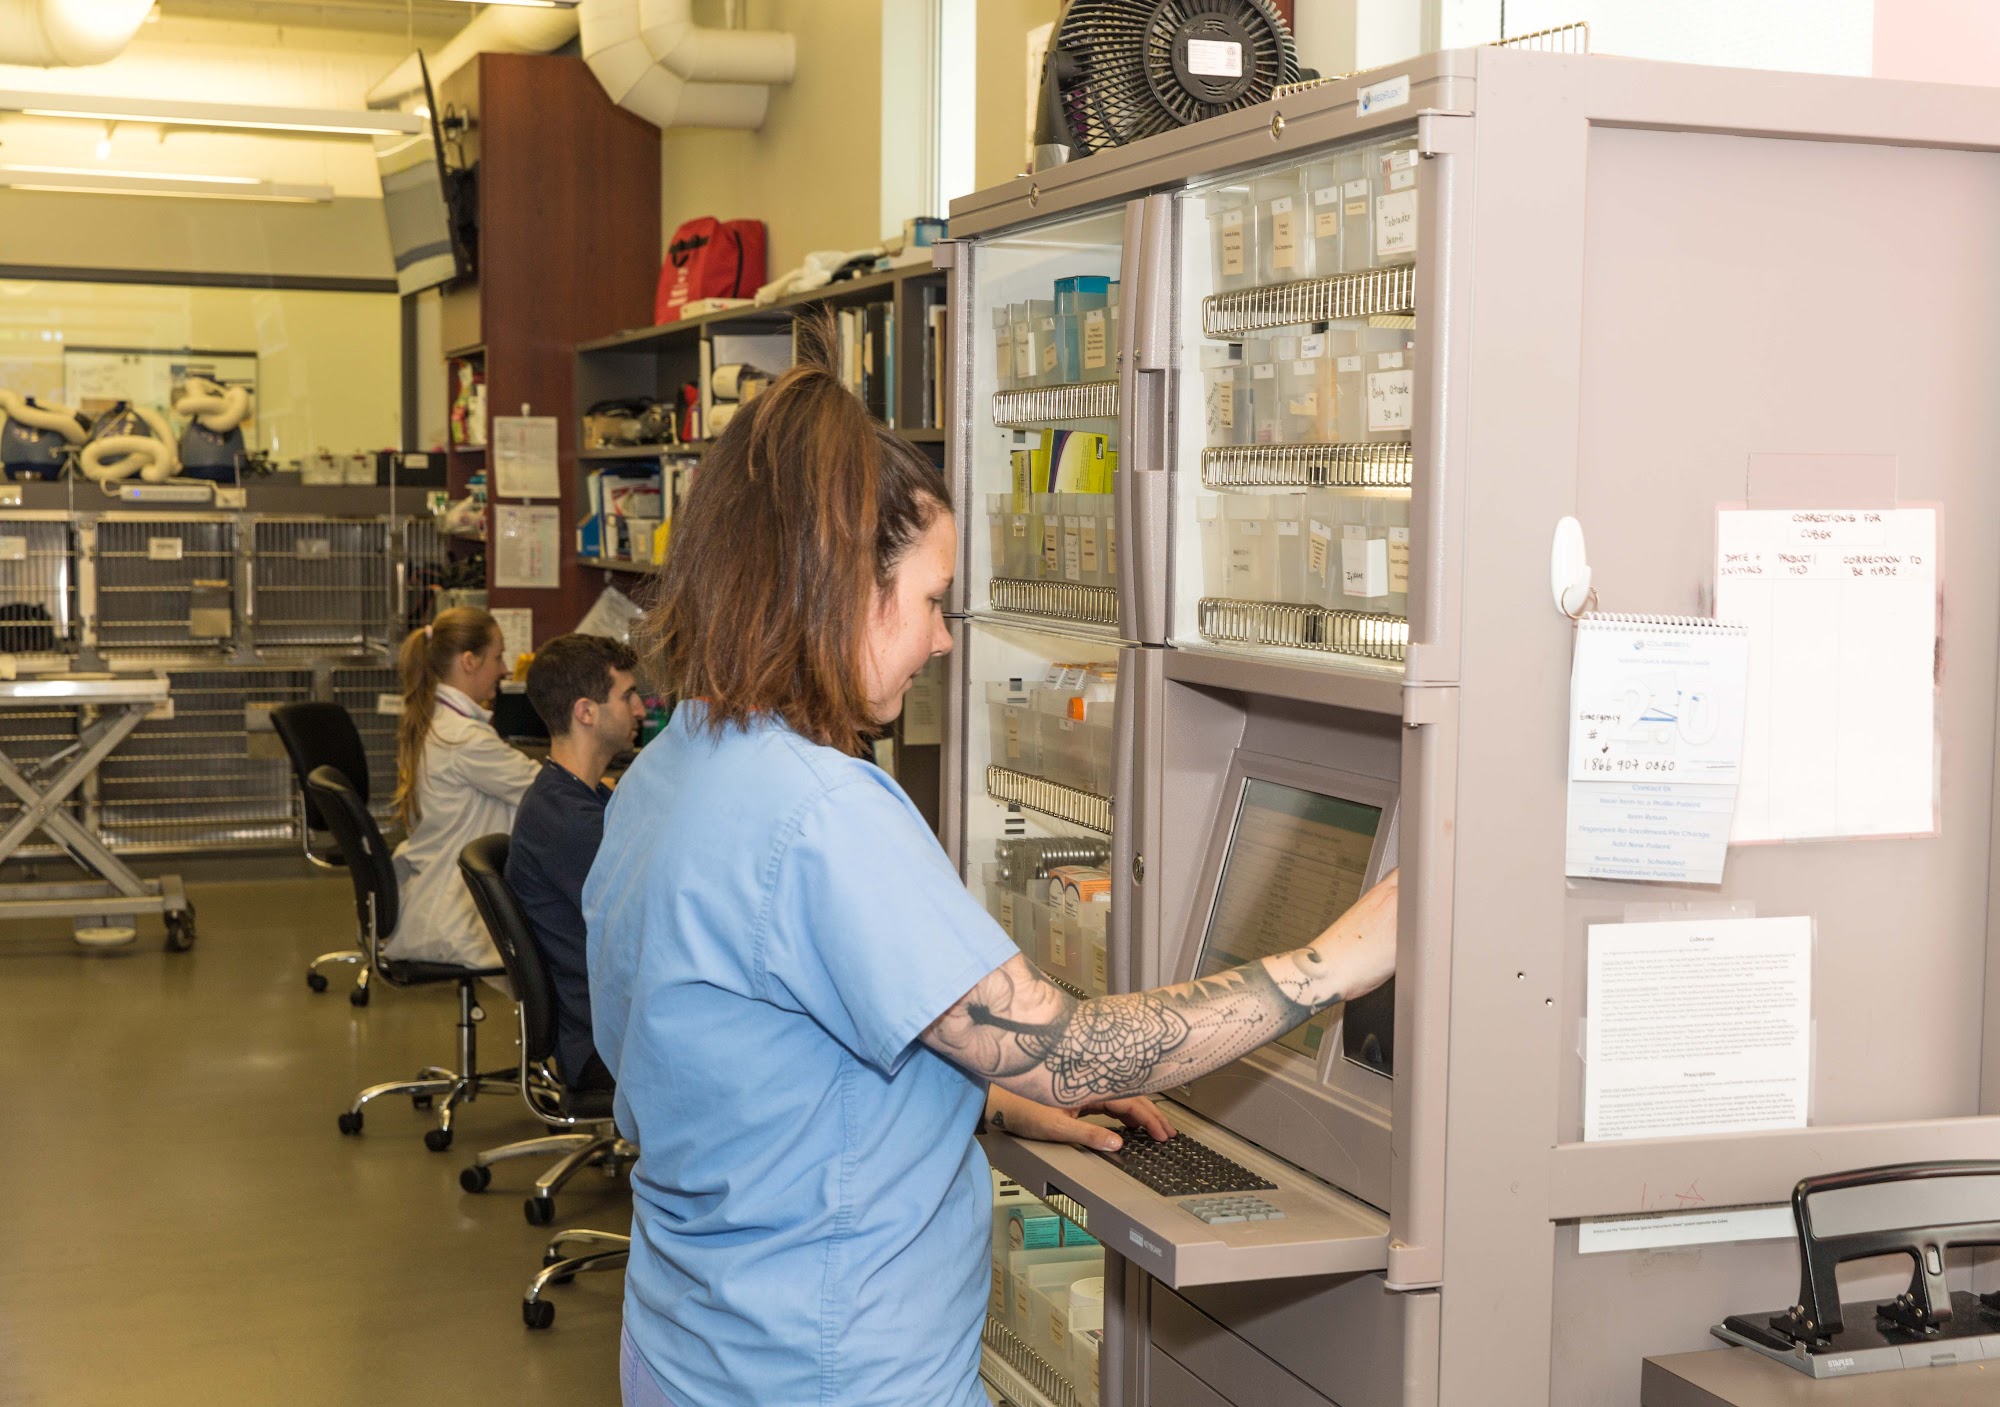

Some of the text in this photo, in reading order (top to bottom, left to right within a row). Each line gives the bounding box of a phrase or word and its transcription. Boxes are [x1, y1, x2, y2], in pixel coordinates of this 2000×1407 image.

[1792, 513, 1881, 523] CORRECTIONS FOR
[1800, 529, 1832, 539] CUBEX
[1725, 554, 1749, 563] DATE
[1843, 554, 1922, 565] CORRECTION TO
[1852, 566, 1897, 576] BE MADE
[1592, 758, 1612, 771] 866
[1617, 759, 1639, 771] 907
[1632, 784, 1661, 792] Contact
[1827, 1357, 1854, 1368] STAPLES
